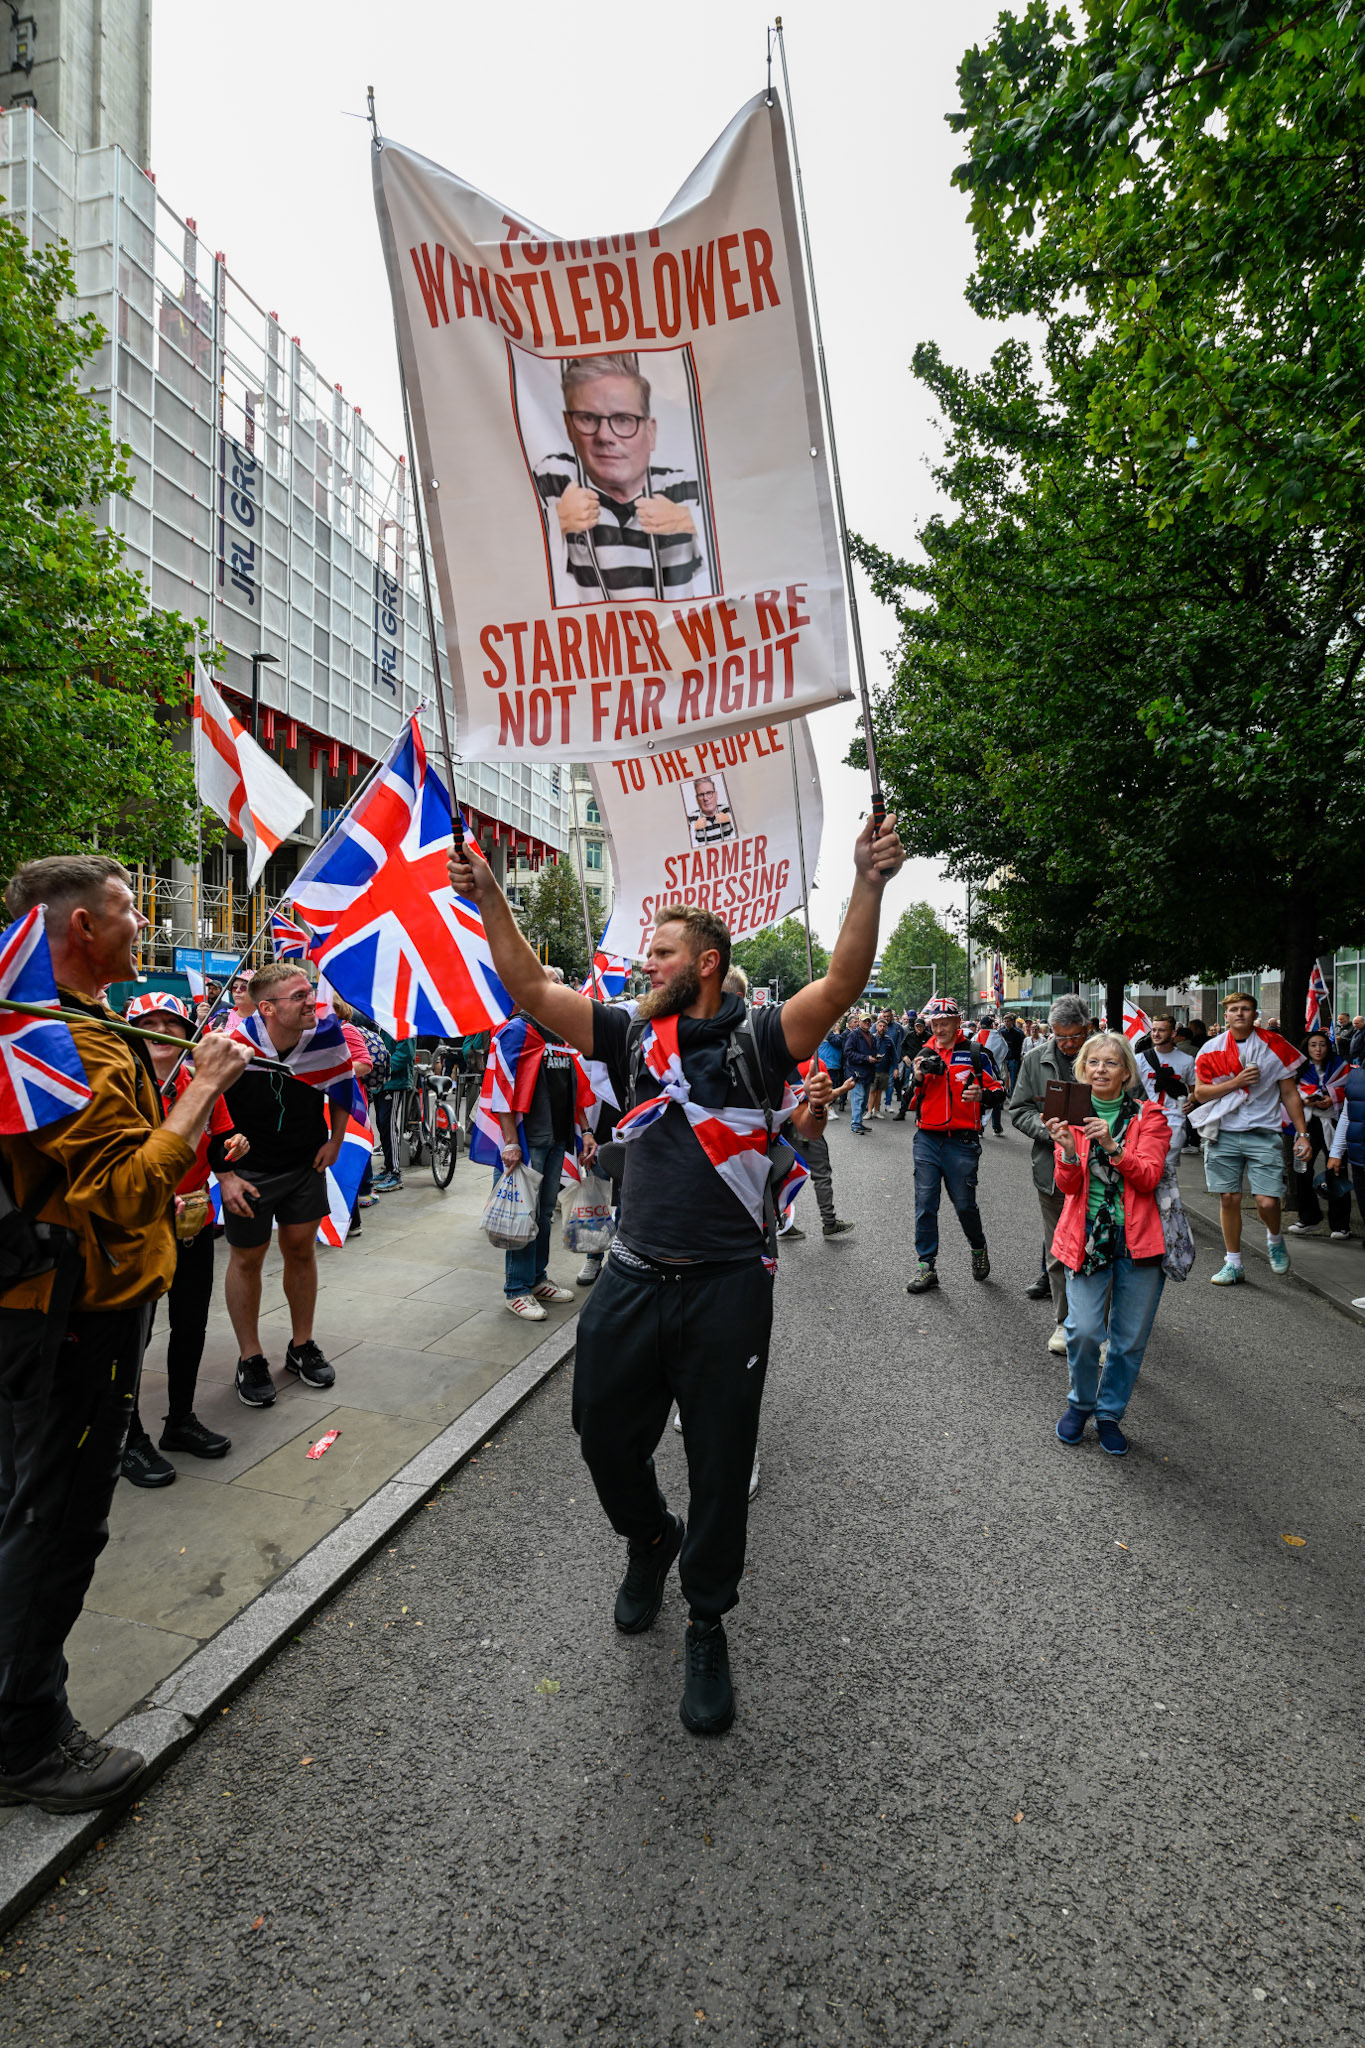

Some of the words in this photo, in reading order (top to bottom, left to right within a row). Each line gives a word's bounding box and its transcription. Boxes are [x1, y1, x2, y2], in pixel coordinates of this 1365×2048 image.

[410, 228, 781, 347] WHISTLEBLOWER
[231, 541, 255, 606] JRL
[479, 610, 673, 688] STARMER
[672, 583, 811, 663] WE'RE
[382, 646, 396, 696] JRL
[498, 685, 576, 747] NOT
[591, 677, 666, 742] FAR
[678, 632, 799, 725] RIGHT
[612, 758, 646, 794] TO
[649, 750, 693, 785] THE
[694, 725, 784, 774] PEOPLE
[664, 835, 768, 889] STARMER
[717, 891, 781, 937] EECH
[572, 1205, 610, 1218] ESCO
